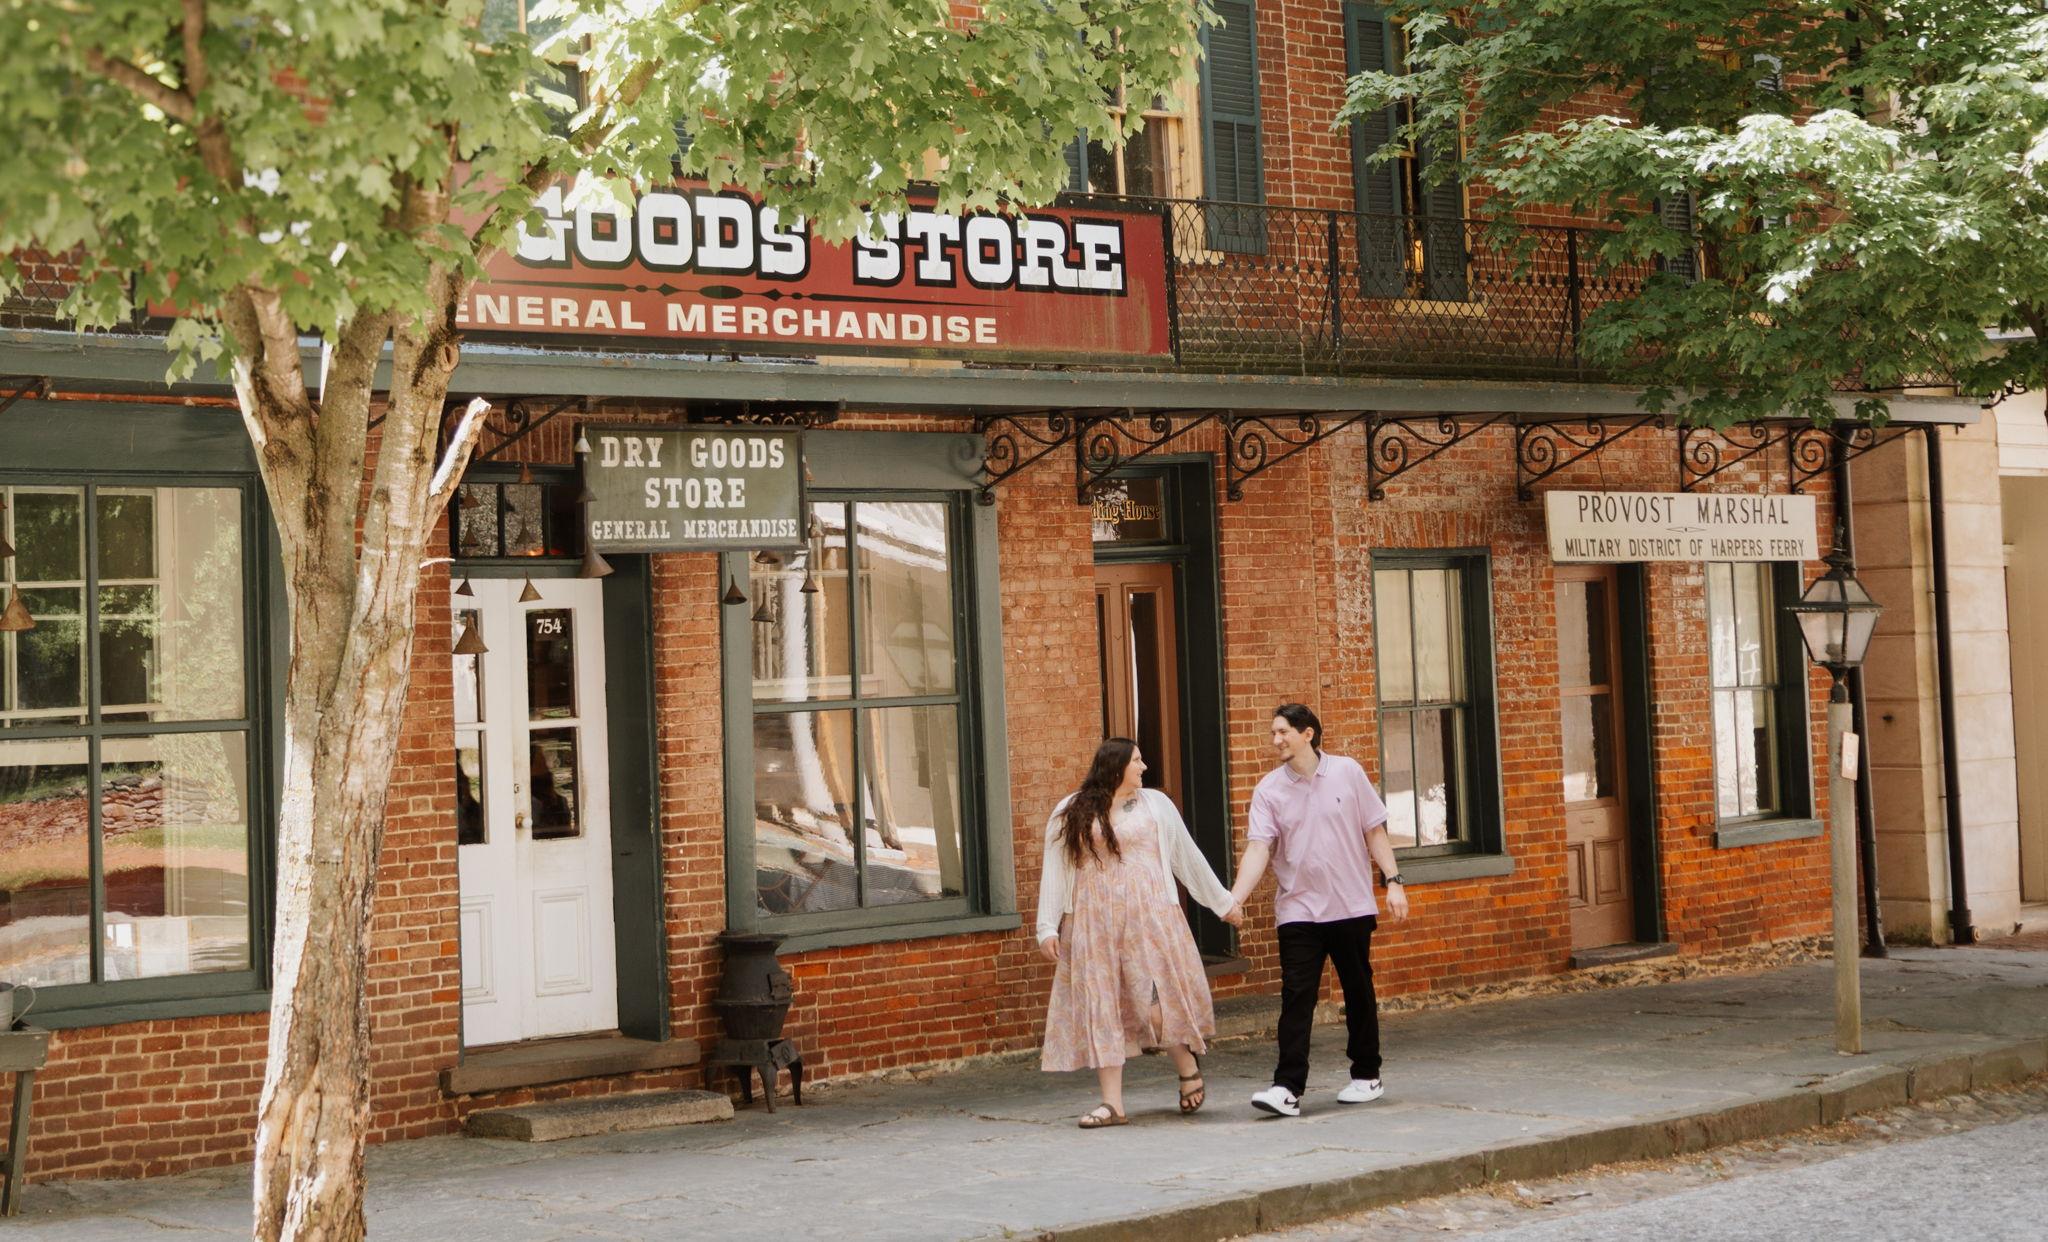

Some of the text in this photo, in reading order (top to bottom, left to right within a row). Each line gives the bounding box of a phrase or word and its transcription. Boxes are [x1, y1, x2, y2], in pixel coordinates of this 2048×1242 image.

[516, 184, 1124, 291] GOODS STORE
[667, 303, 998, 344] MERCHANDISE
[600, 436, 785, 469] DRY GOODS
[645, 477, 746, 509] STORE
[1579, 494, 1790, 525] PROVOST MARSHAL
[591, 518, 797, 540] GENERAL MERCHANDISE
[1564, 537, 1805, 558] MILITARY DISTRICT OF HARPERS FERRY
[536, 617, 562, 635] 754
